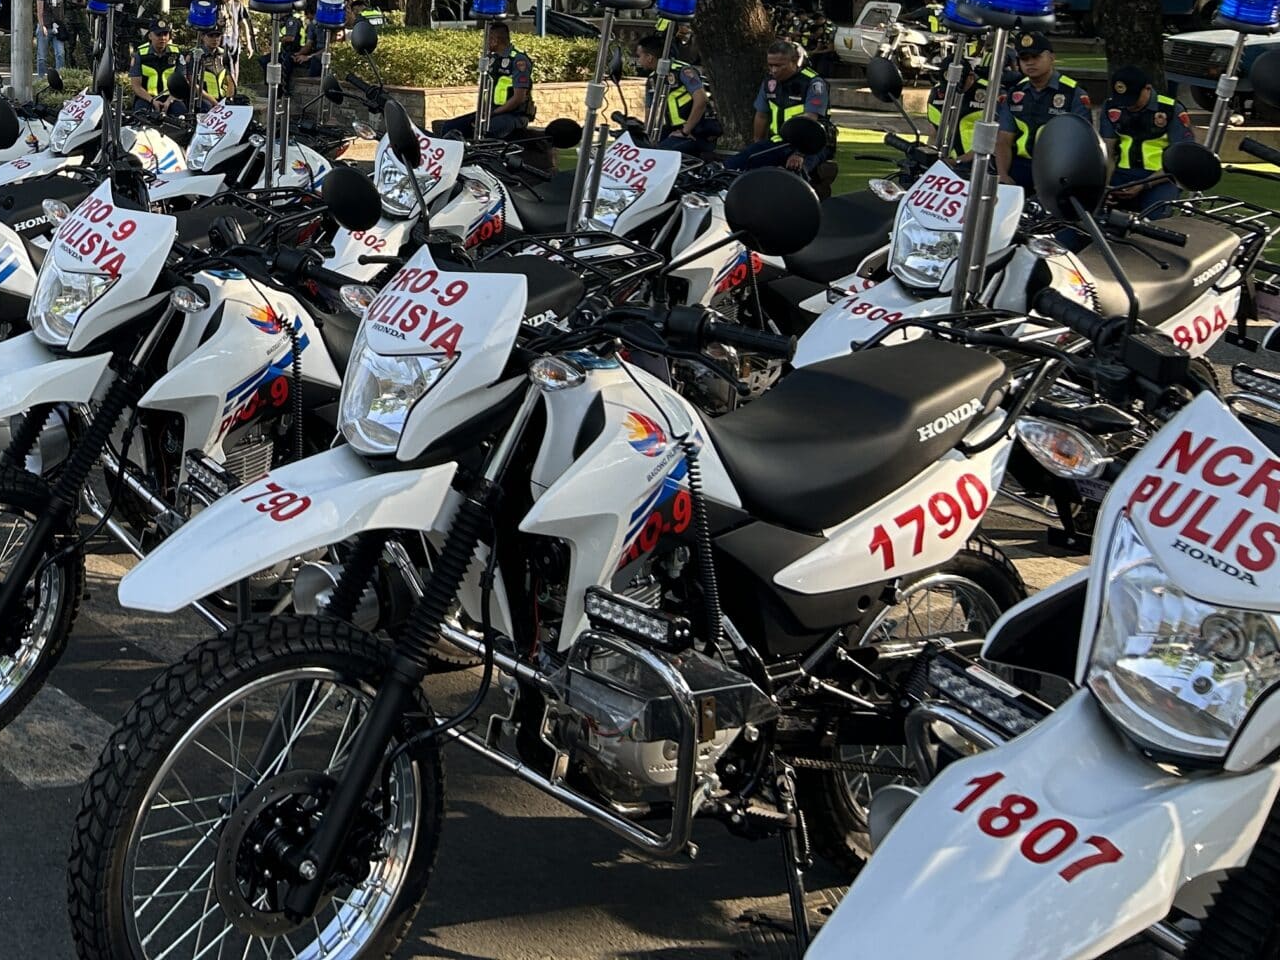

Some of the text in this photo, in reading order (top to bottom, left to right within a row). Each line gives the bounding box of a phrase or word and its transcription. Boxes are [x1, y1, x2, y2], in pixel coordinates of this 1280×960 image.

[611, 143, 656, 172] PRO-9
[909, 190, 967, 225] PULIS
[918, 175, 970, 198] PRO-
[14, 214, 51, 233] HON
[59, 216, 126, 280] ULISYA
[368, 294, 465, 359] ULISYA
[842, 296, 905, 325] 1804
[1173, 304, 1228, 350] 804
[917, 398, 985, 441] HONDA
[869, 473, 989, 571] 1790
[1171, 538, 1260, 588] HONDA
[953, 771, 1125, 883] 1807
